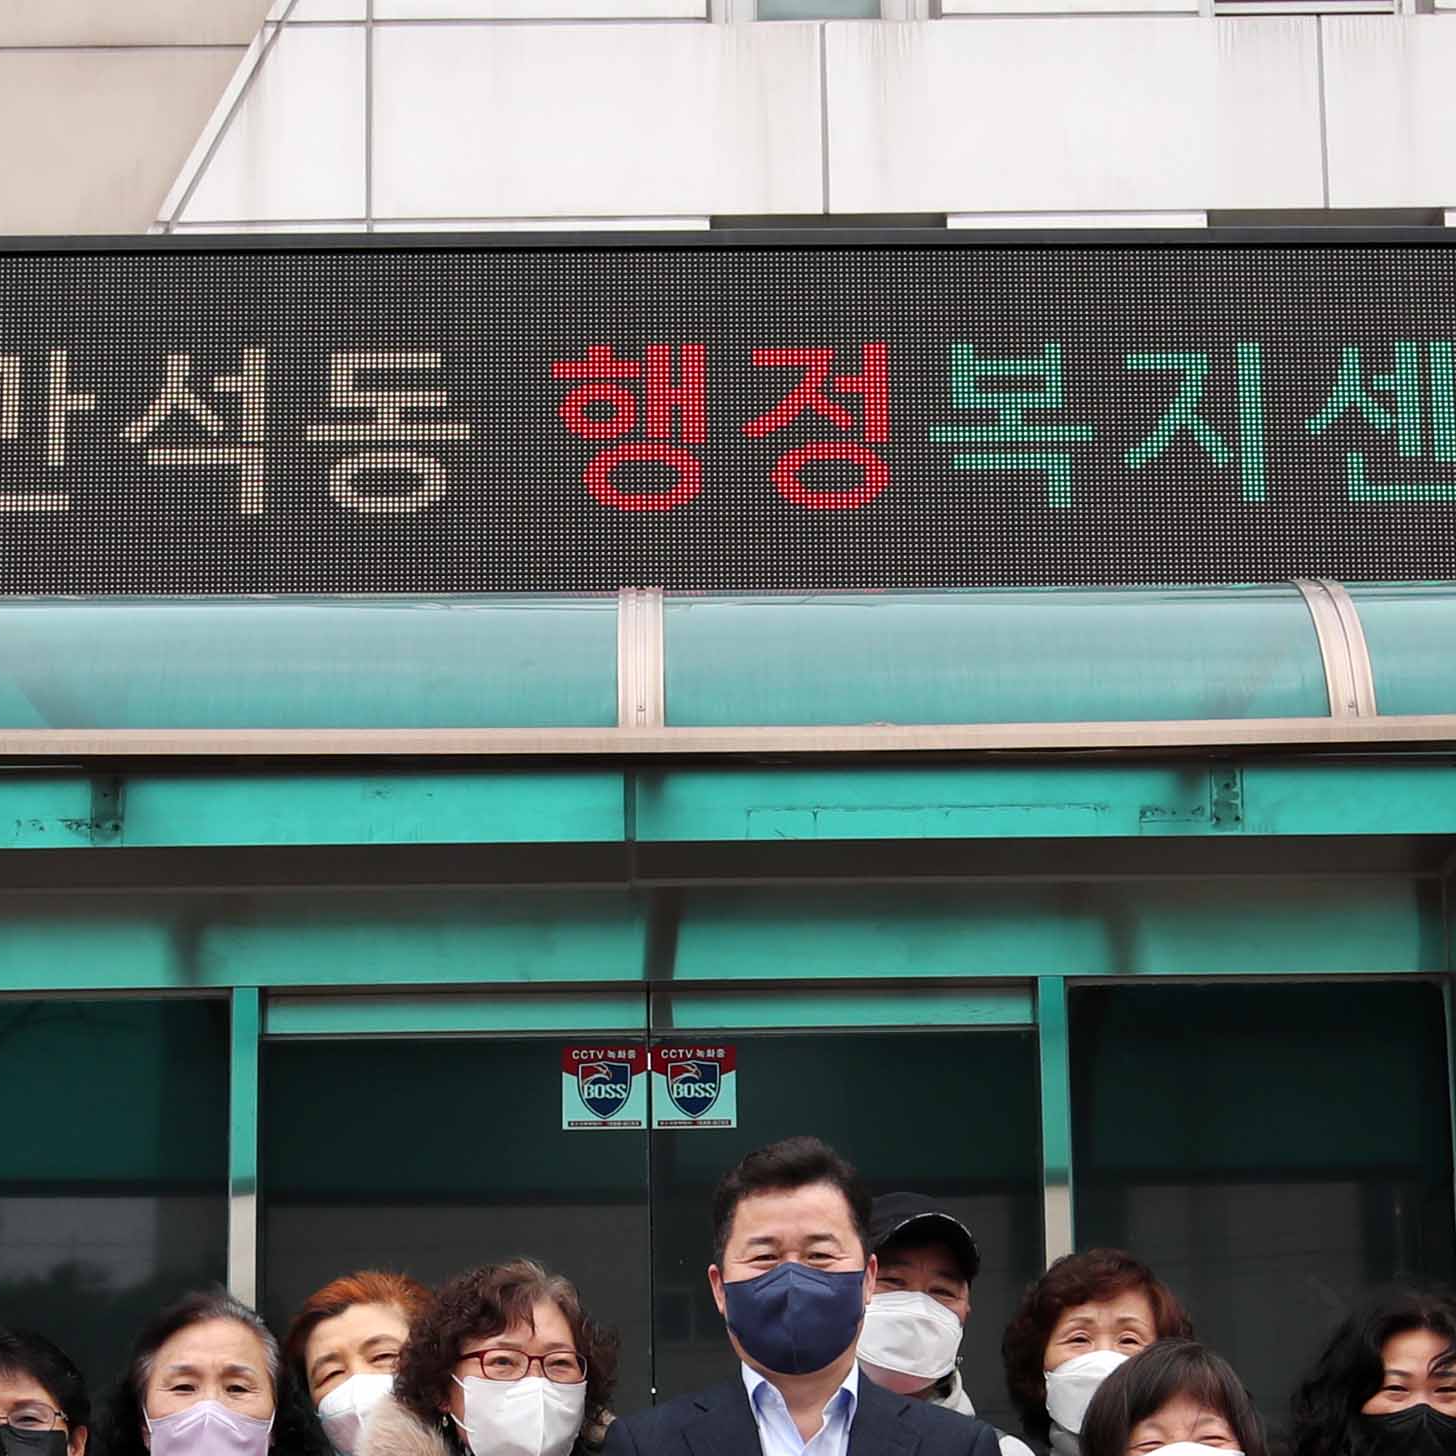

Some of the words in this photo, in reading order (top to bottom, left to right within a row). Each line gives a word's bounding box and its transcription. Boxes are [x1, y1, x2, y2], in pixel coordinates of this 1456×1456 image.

[572, 1050, 604, 1060] CCTV
[661, 1049, 693, 1059] CCTV
[584, 1084, 626, 1099] BOSS
[673, 1083, 716, 1098] BOSS
